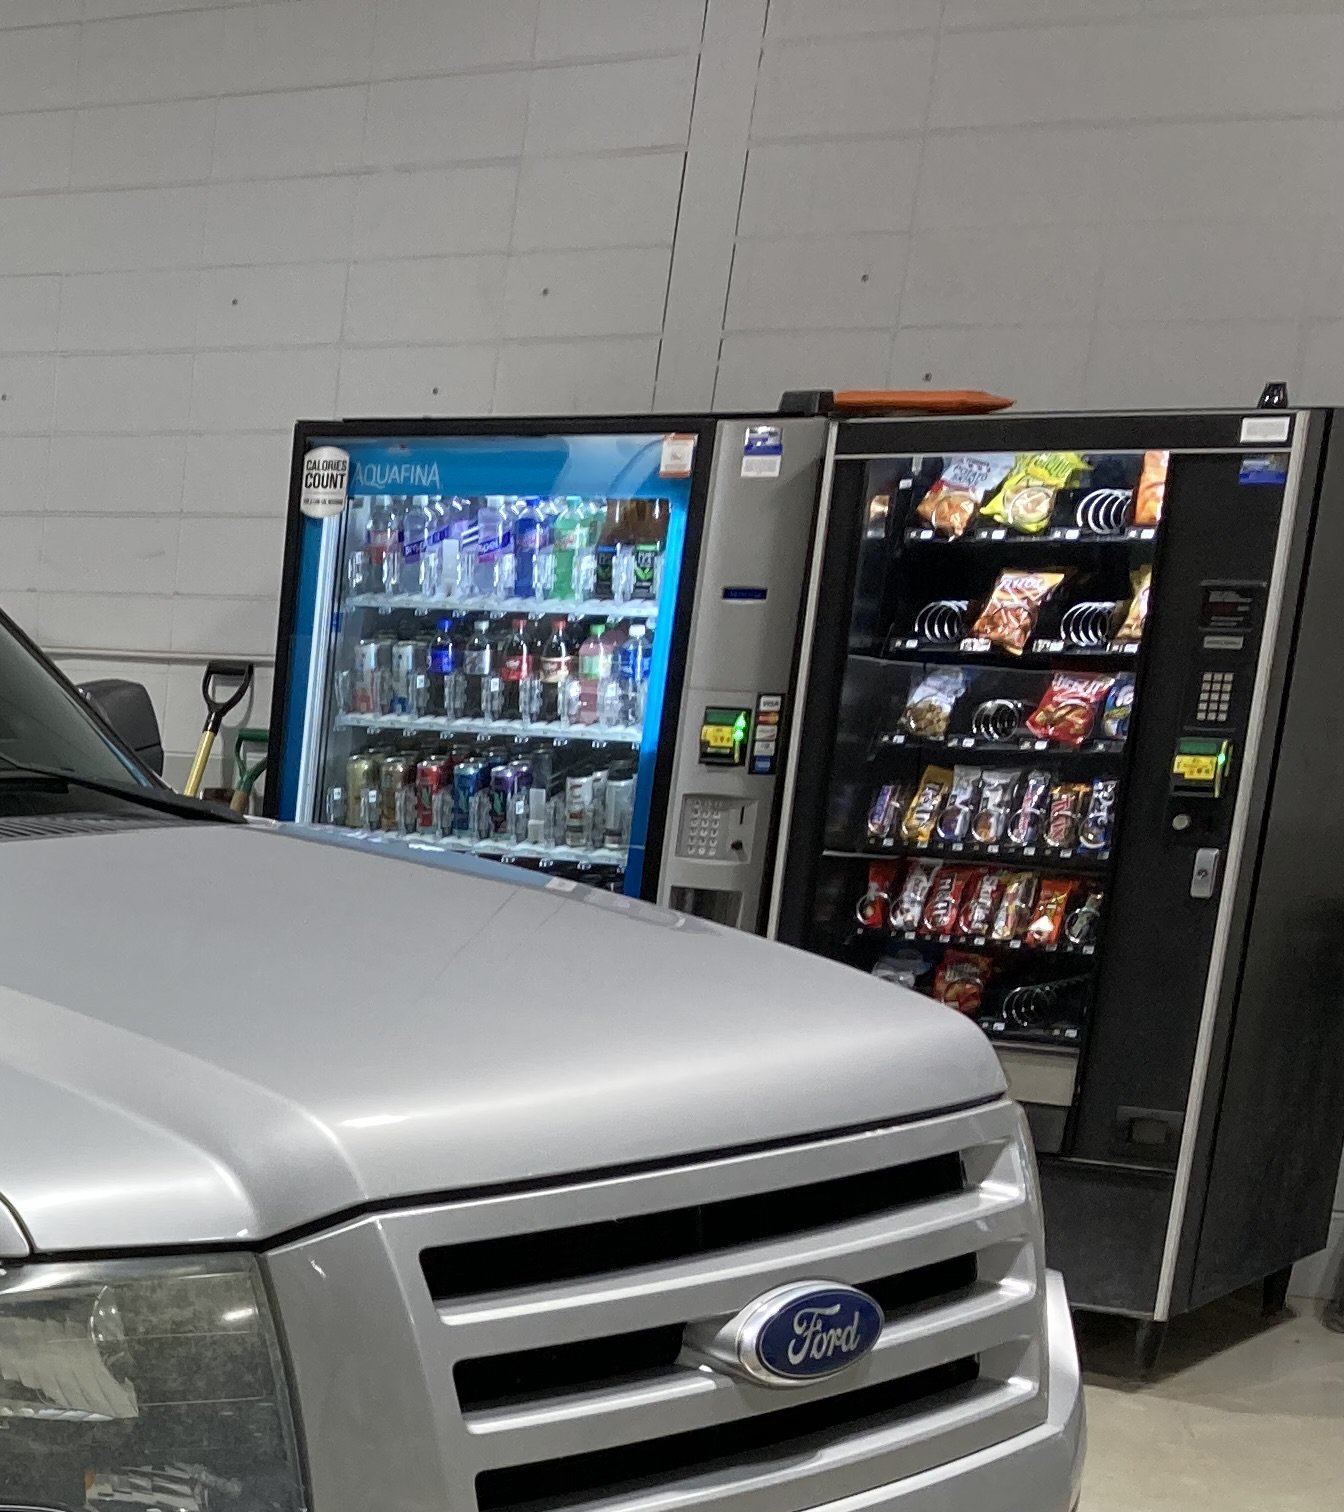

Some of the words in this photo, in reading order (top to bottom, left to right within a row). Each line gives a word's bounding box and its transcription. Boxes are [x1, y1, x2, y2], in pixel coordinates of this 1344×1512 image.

[306, 460, 347, 472] CALORIES
[353, 461, 441, 489] AQUAFINA
[304, 473, 346, 489] COUNT
[787, 1303, 861, 1366] Ford
